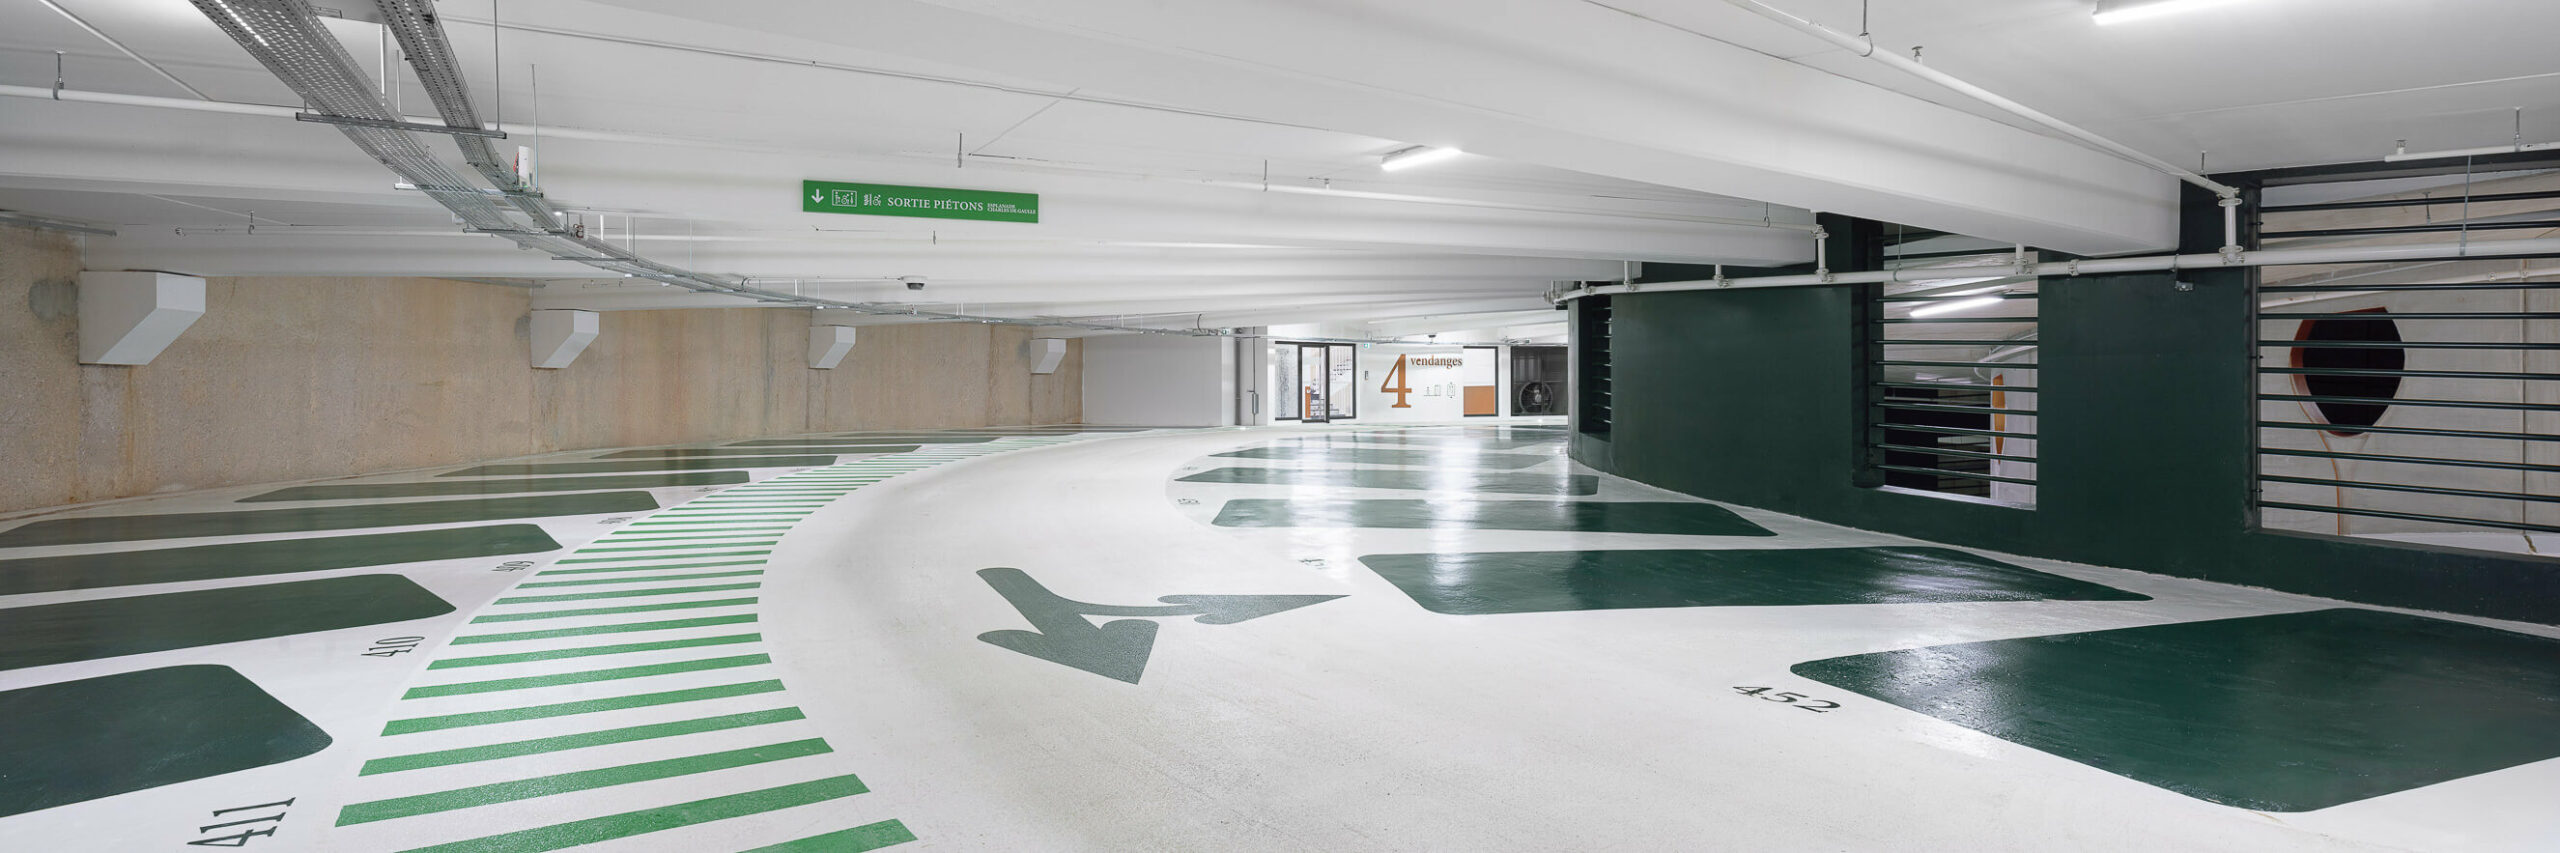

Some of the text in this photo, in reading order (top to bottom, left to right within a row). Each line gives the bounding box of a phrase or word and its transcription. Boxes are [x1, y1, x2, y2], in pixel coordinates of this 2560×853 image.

[887, 197, 984, 211] SORTIE PIÉTONS
[1381, 353, 1463, 408] 4 vendanges
[360, 635, 426, 658] 410
[1732, 685, 1841, 714] 452
[186, 796, 297, 847] 411
